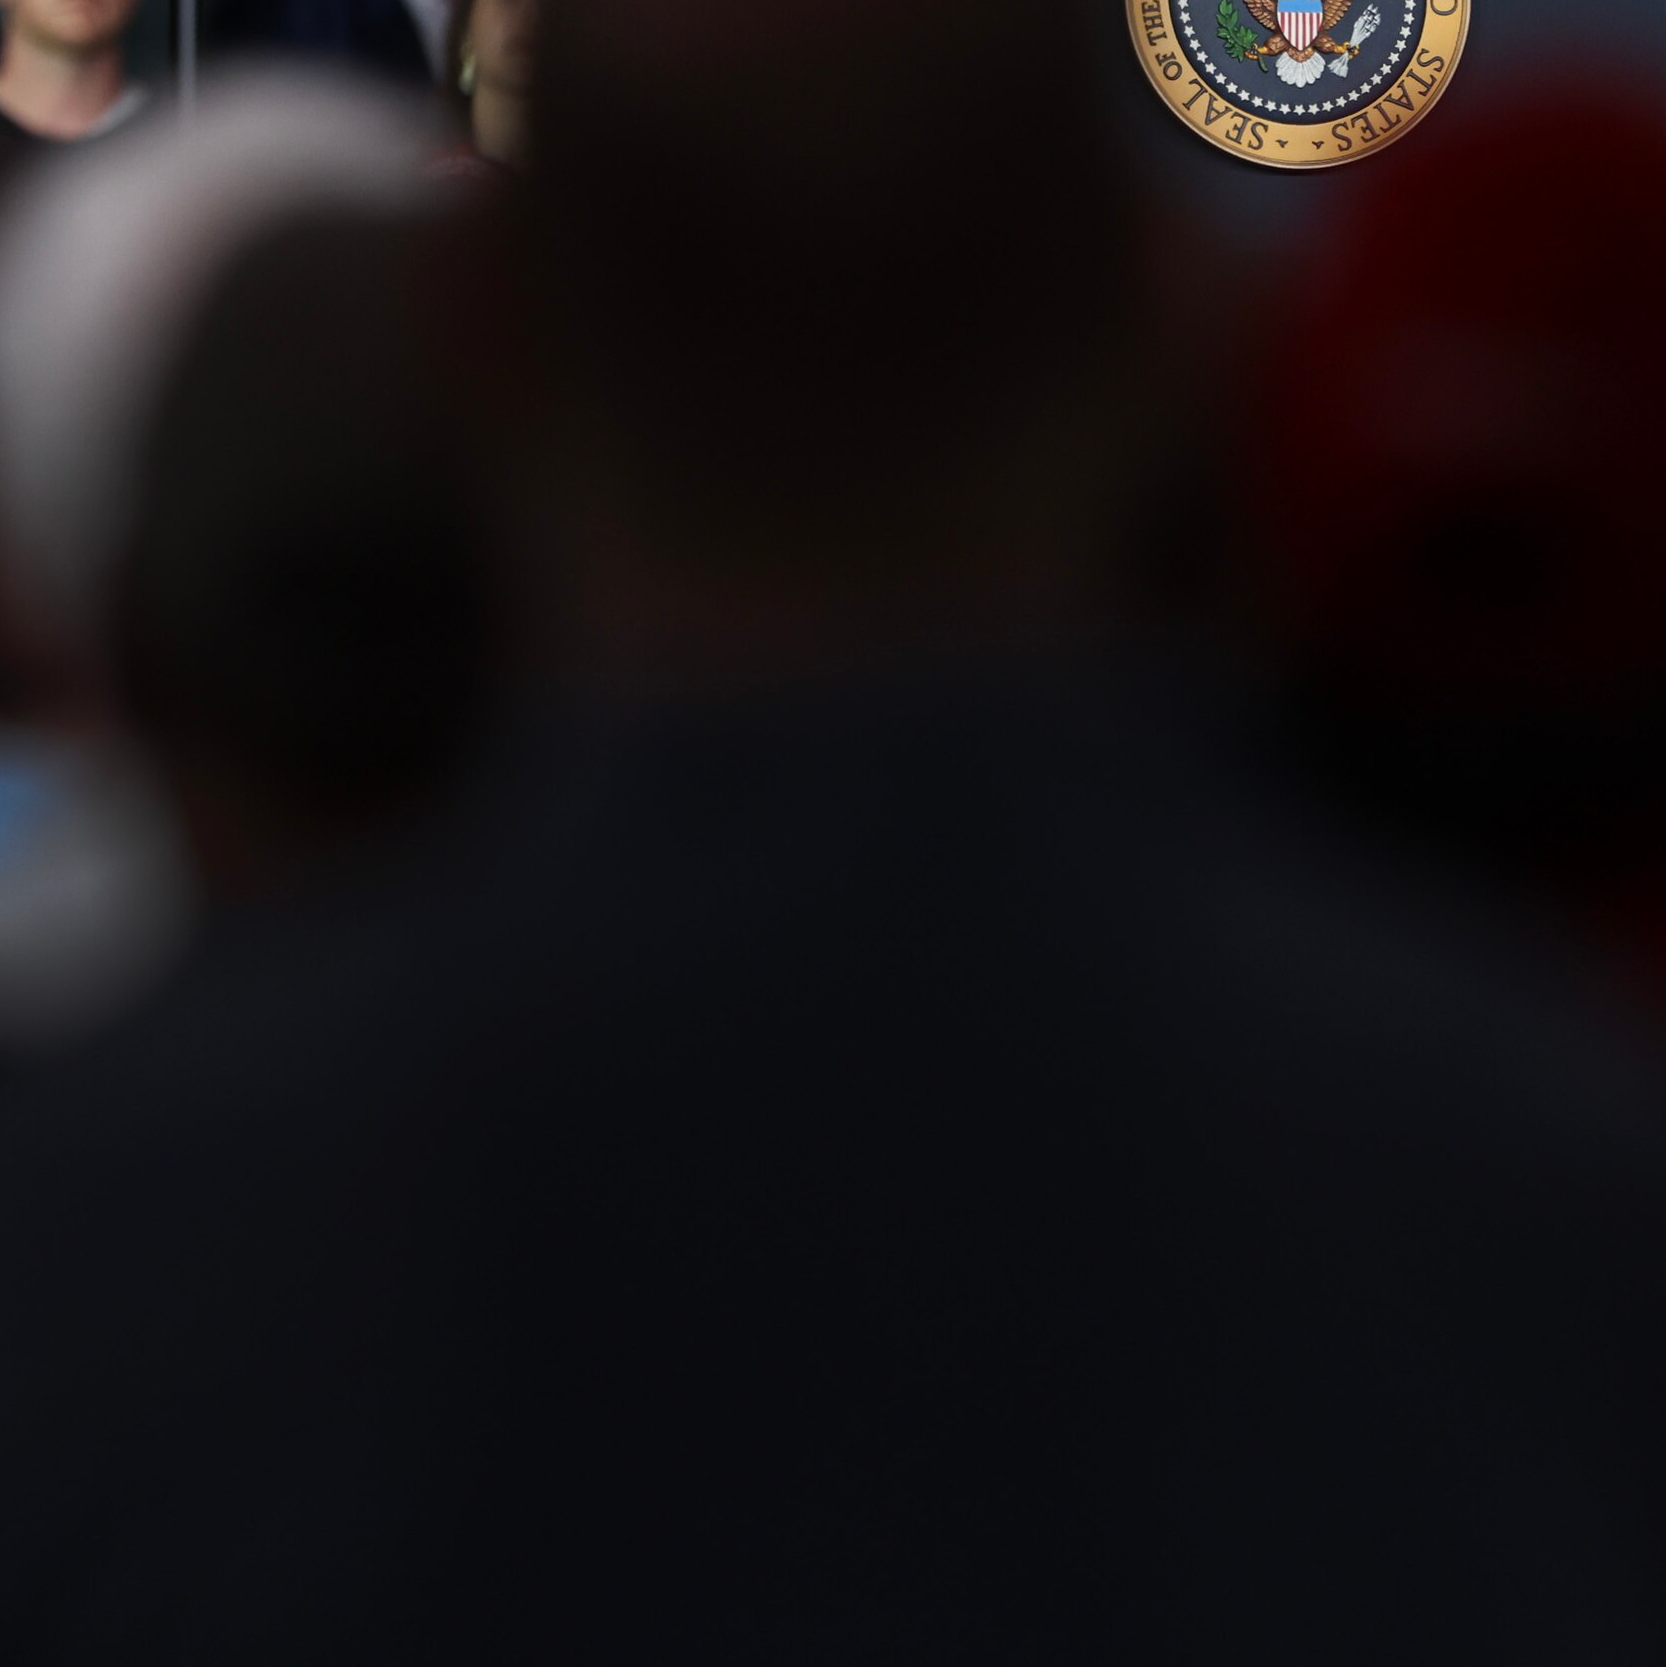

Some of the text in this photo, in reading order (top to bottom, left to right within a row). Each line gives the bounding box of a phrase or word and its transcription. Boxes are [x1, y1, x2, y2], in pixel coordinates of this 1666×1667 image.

[1141, 0, 1168, 47] THE
[1154, 51, 1183, 81] OF
[1181, 78, 1269, 151] SEAL
[1331, 48, 1445, 152] STATES
